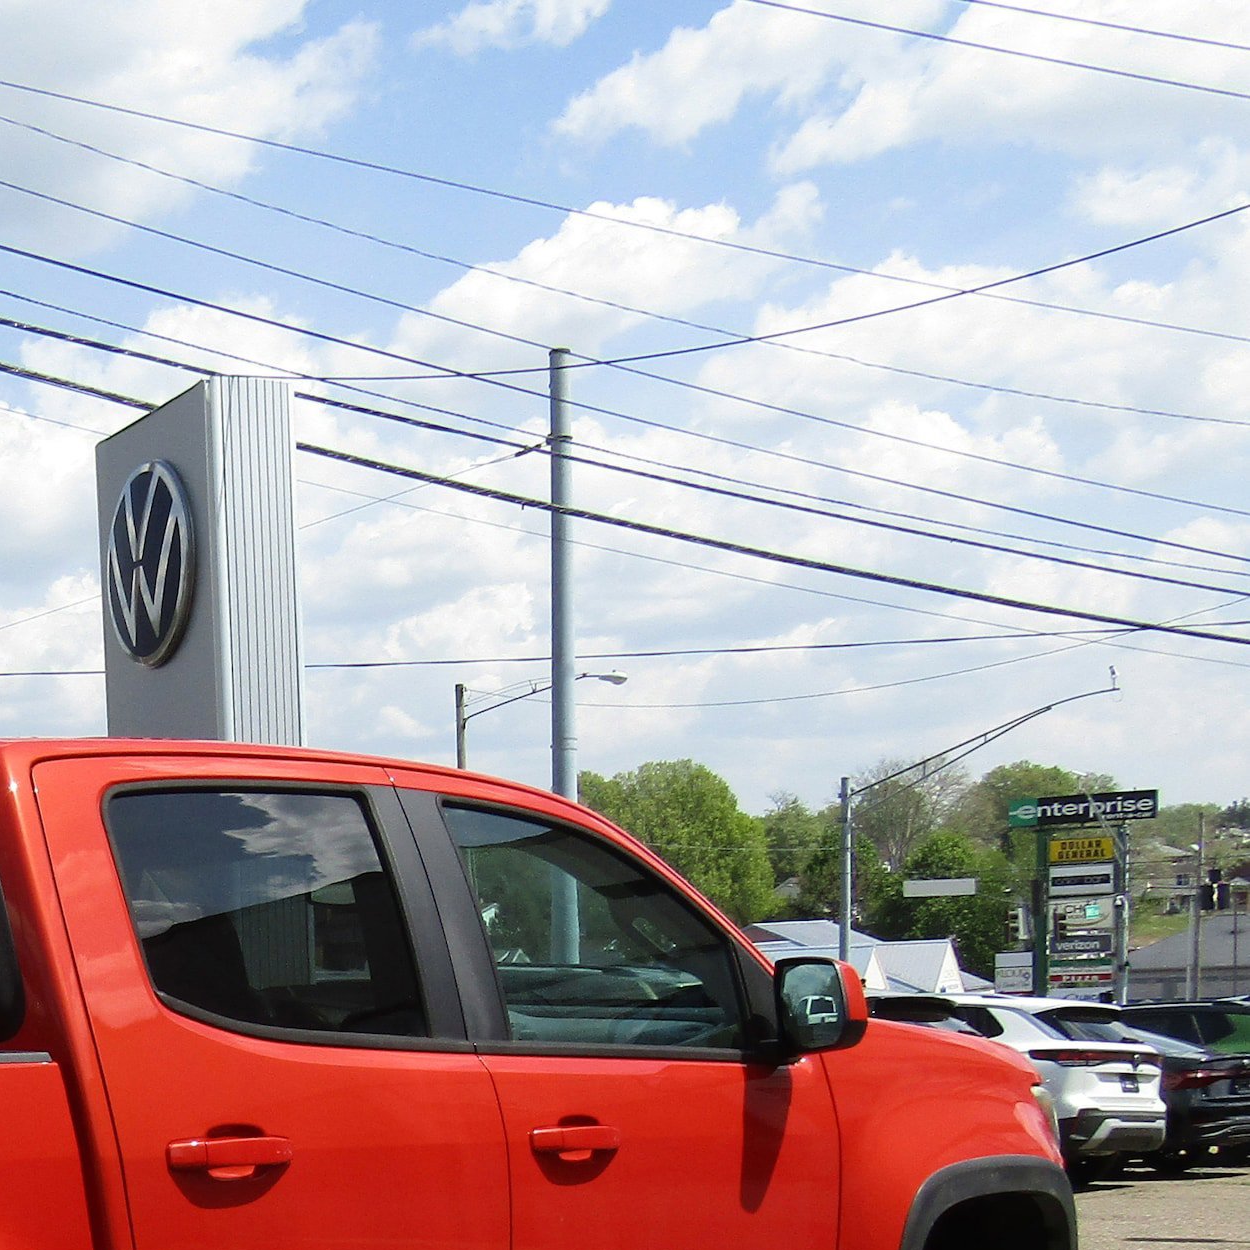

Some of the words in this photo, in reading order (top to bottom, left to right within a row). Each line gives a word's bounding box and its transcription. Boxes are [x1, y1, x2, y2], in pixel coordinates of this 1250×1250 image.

[1009, 796, 1154, 819] enterprise
[1060, 839, 1102, 850] DOLLAR
[1058, 849, 1106, 860] GENERAL
[1056, 940, 1100, 951] verizon
